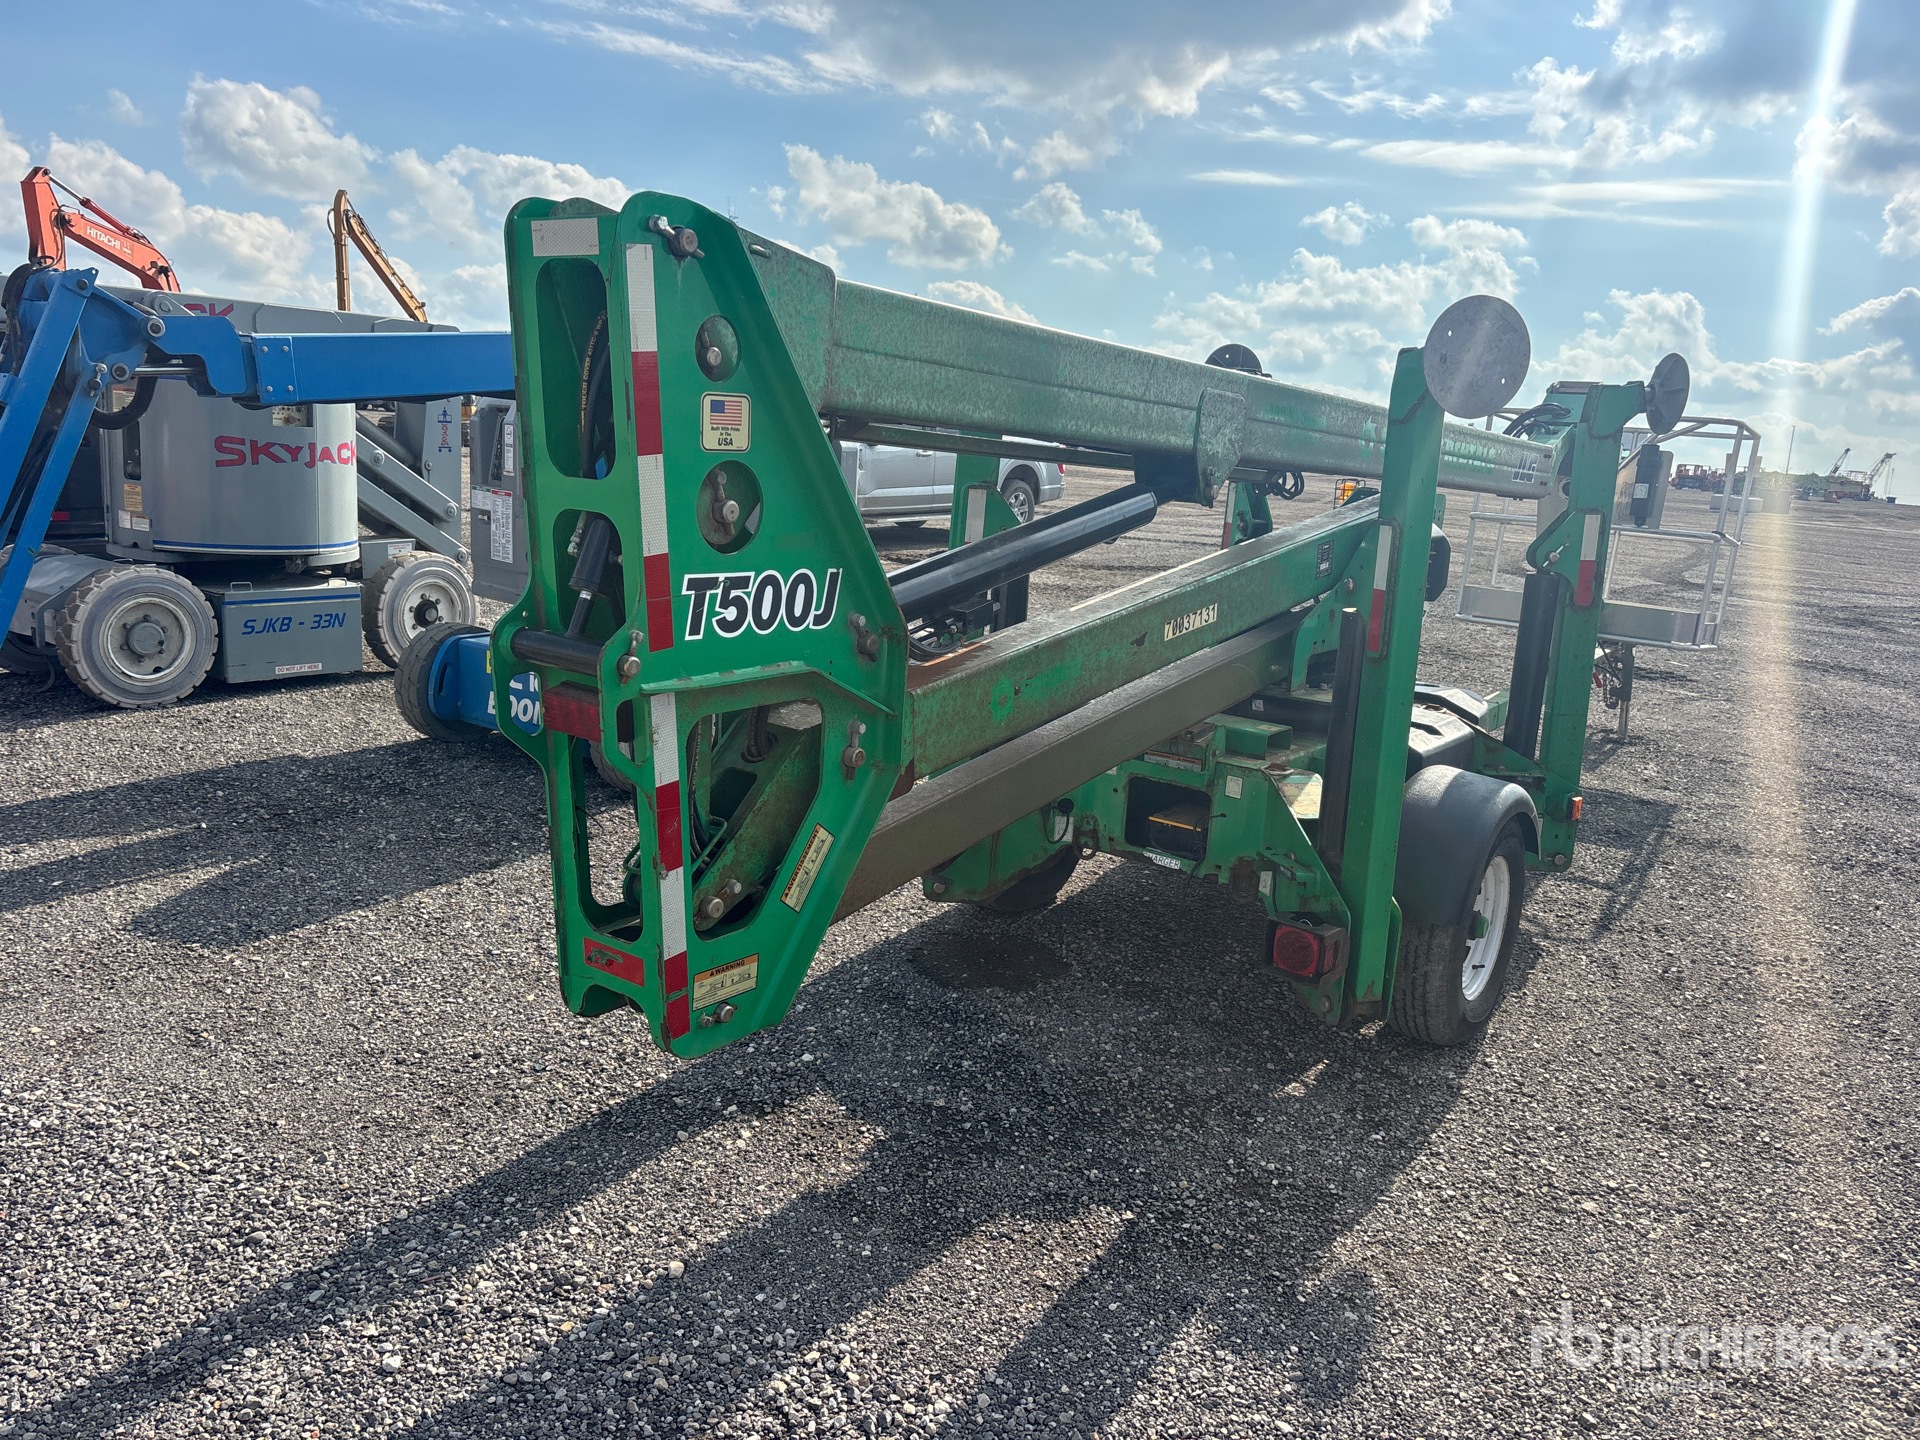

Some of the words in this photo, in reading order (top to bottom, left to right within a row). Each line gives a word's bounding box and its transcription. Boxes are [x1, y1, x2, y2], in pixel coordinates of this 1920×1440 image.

[86, 226, 120, 250] HITACHI
[583, 358, 591, 380] COVER
[214, 435, 357, 469] SKYJACK
[718, 437, 734, 446] USA
[681, 568, 843, 641] T500J
[241, 616, 293, 636] SJKB
[310, 612, 347, 631] 33N
[1165, 603, 1216, 639] 70037131
[787, 829, 819, 892] AVERTISSEMENT
[715, 960, 746, 975] WARNING
